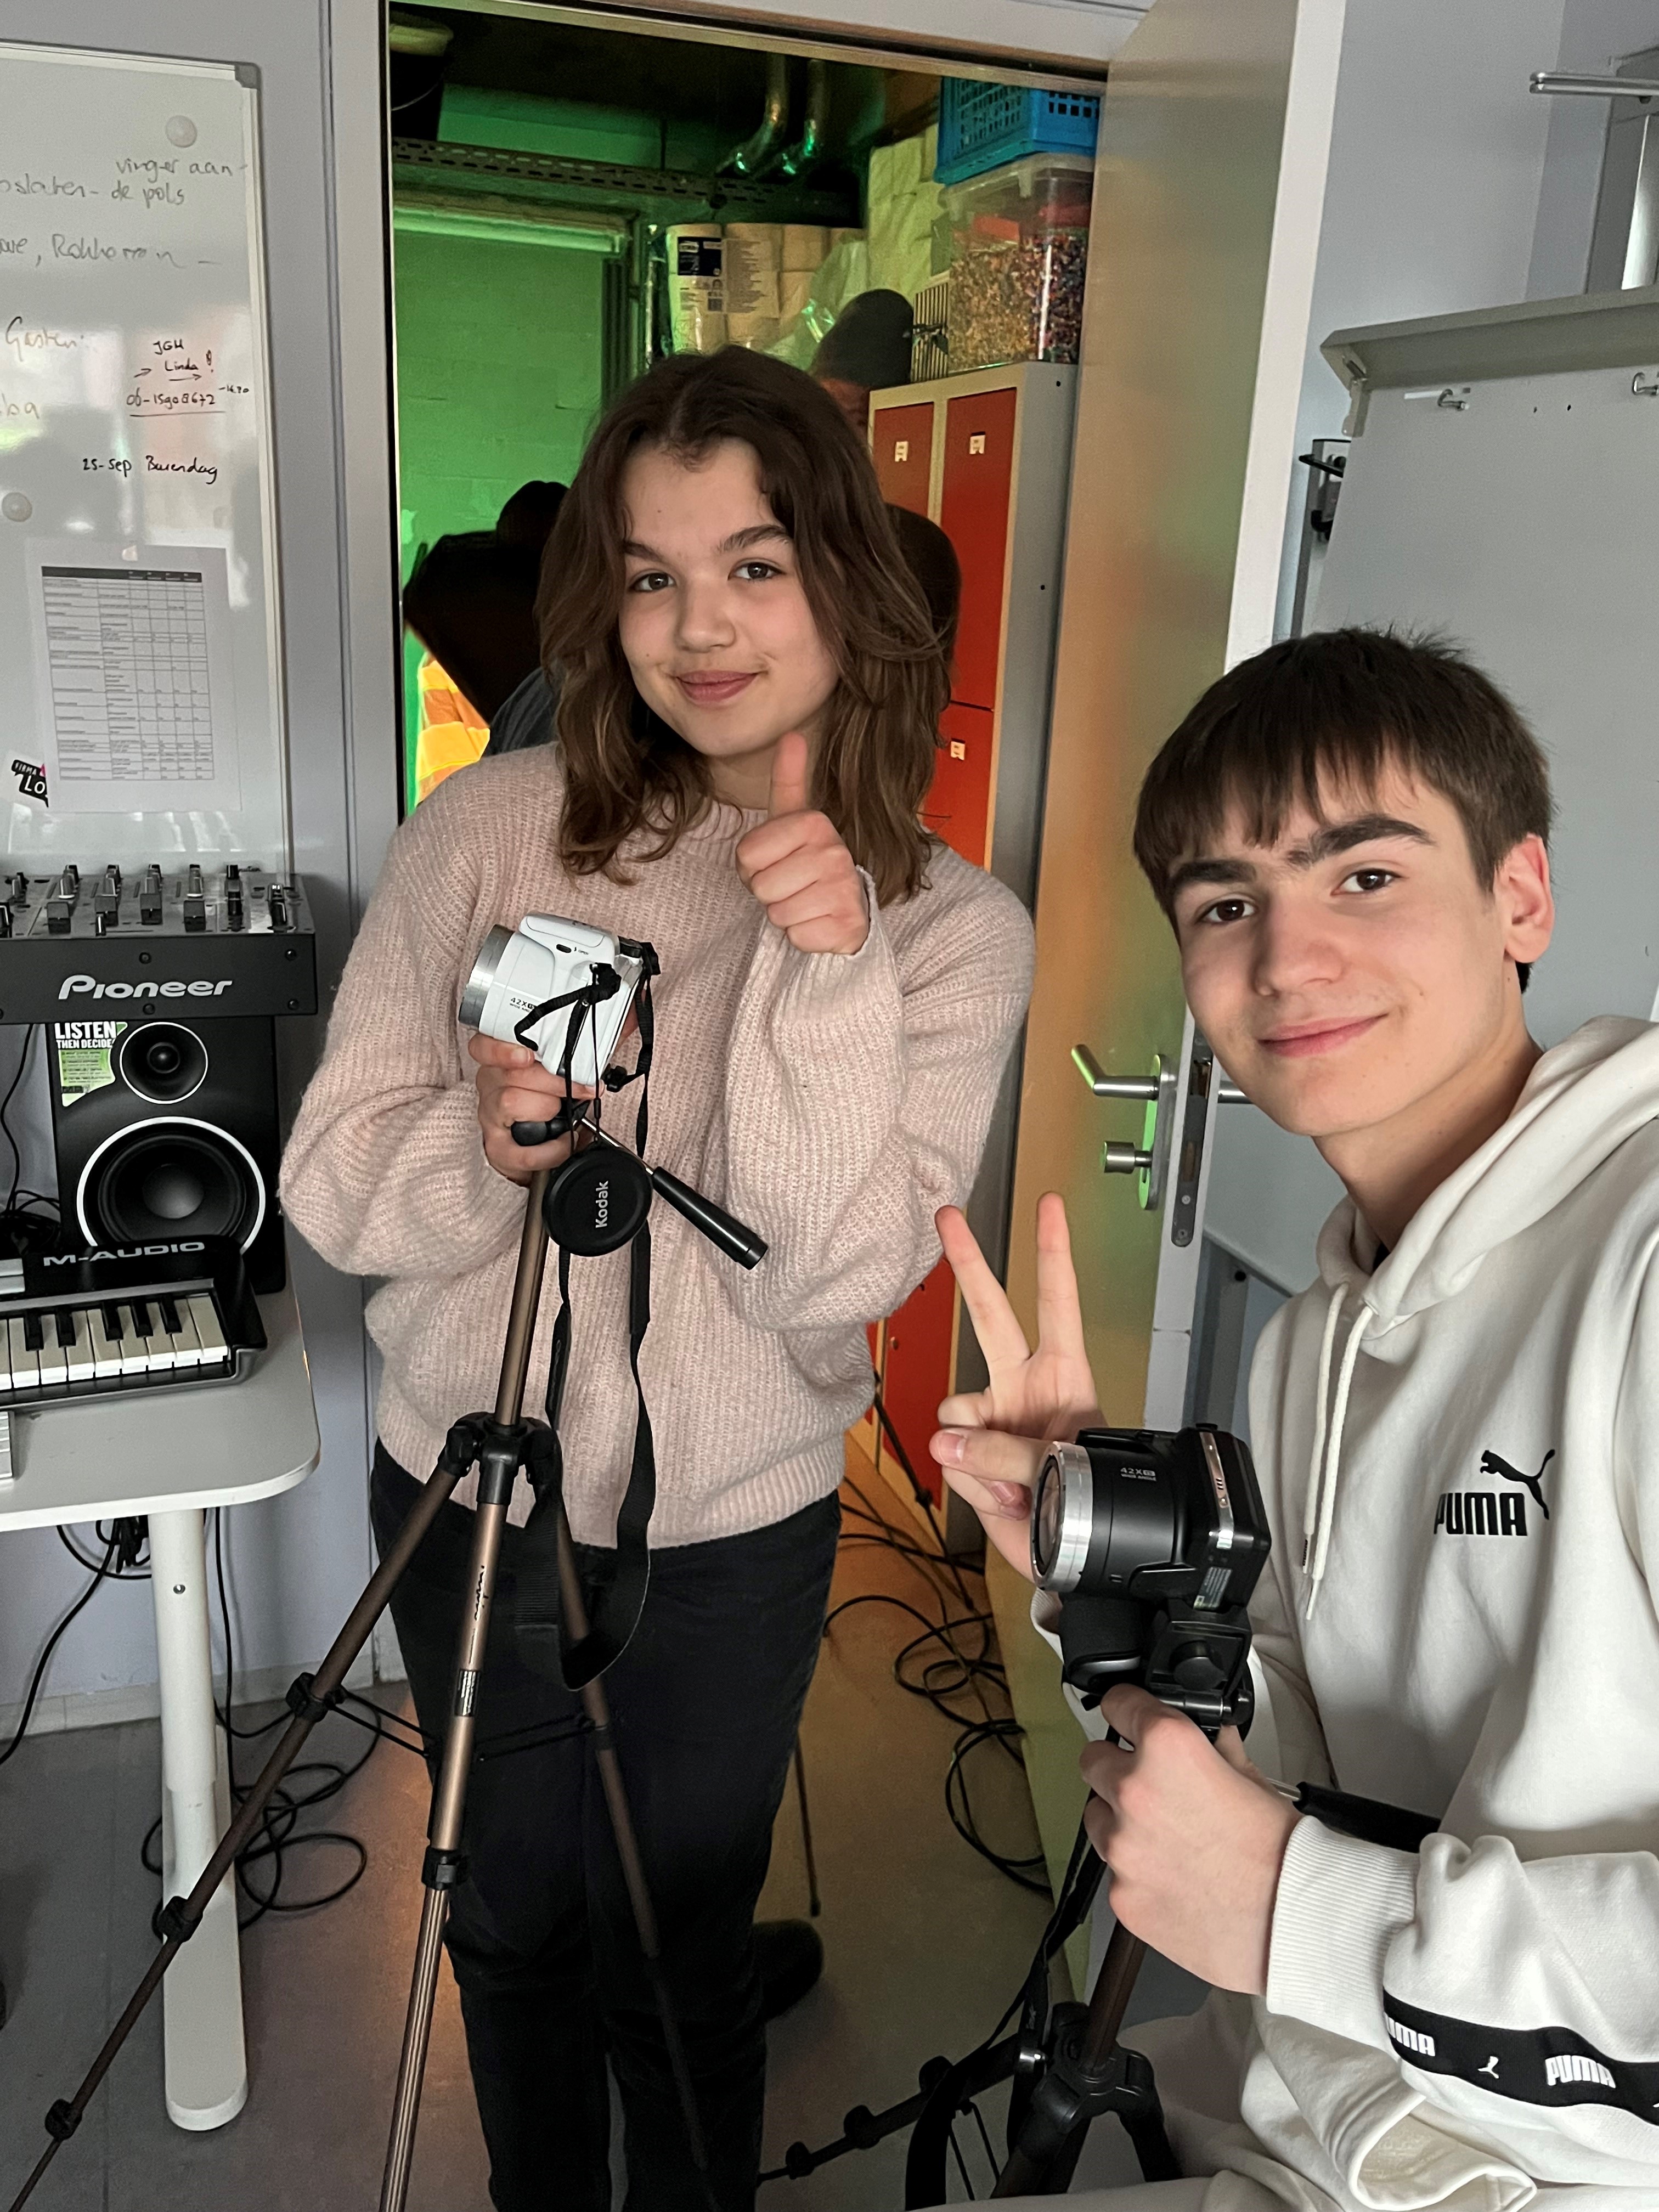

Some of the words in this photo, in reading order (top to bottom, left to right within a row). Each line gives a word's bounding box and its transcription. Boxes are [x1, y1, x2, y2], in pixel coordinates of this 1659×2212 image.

[58, 974, 233, 1000] Pioneer
[54, 1021, 117, 1040] LISTEN
[56, 1039, 80, 1049] THEN
[595, 1180, 609, 1228] Kodak
[43, 1242, 205, 1266] M-AUDIO
[1434, 1492, 1528, 1536] PUMA
[1384, 2012, 1436, 2057] UMA
[1545, 2055, 1616, 2089] PUMA
